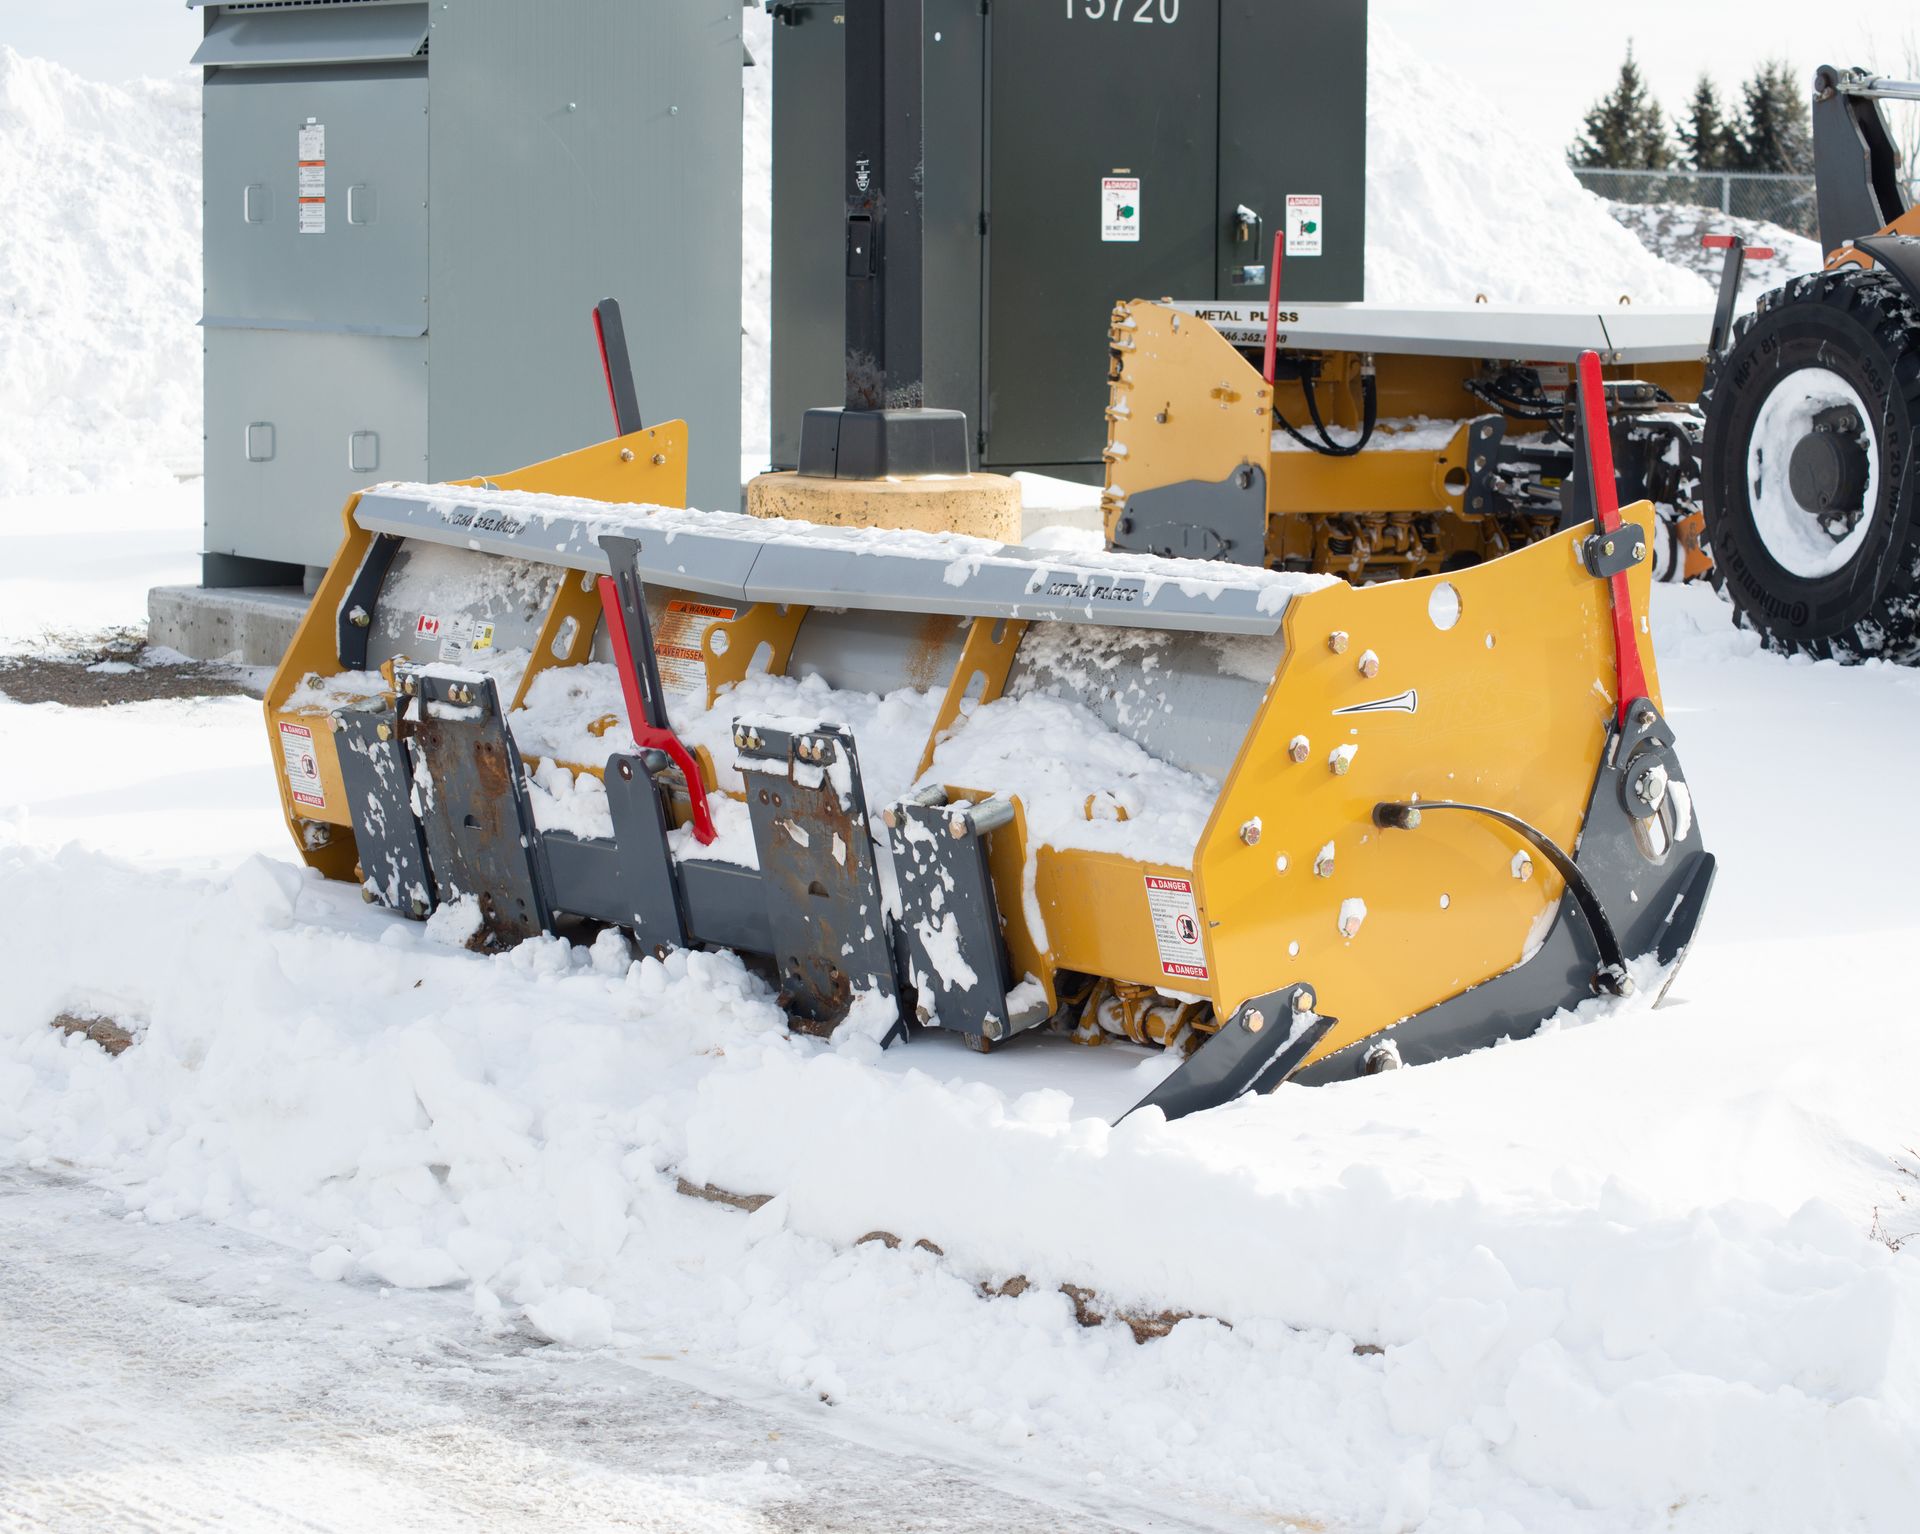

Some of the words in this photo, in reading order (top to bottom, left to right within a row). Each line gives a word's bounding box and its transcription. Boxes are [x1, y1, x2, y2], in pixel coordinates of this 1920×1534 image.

[1195, 310, 1242, 321] METAL
[1250, 311, 1299, 322] PLSS
[689, 604, 722, 617] WARNING
[288, 725, 309, 736] DANGER
[302, 794, 322, 806] DANGER
[1158, 880, 1188, 891] DANGER
[1174, 964, 1205, 977] DANGER
